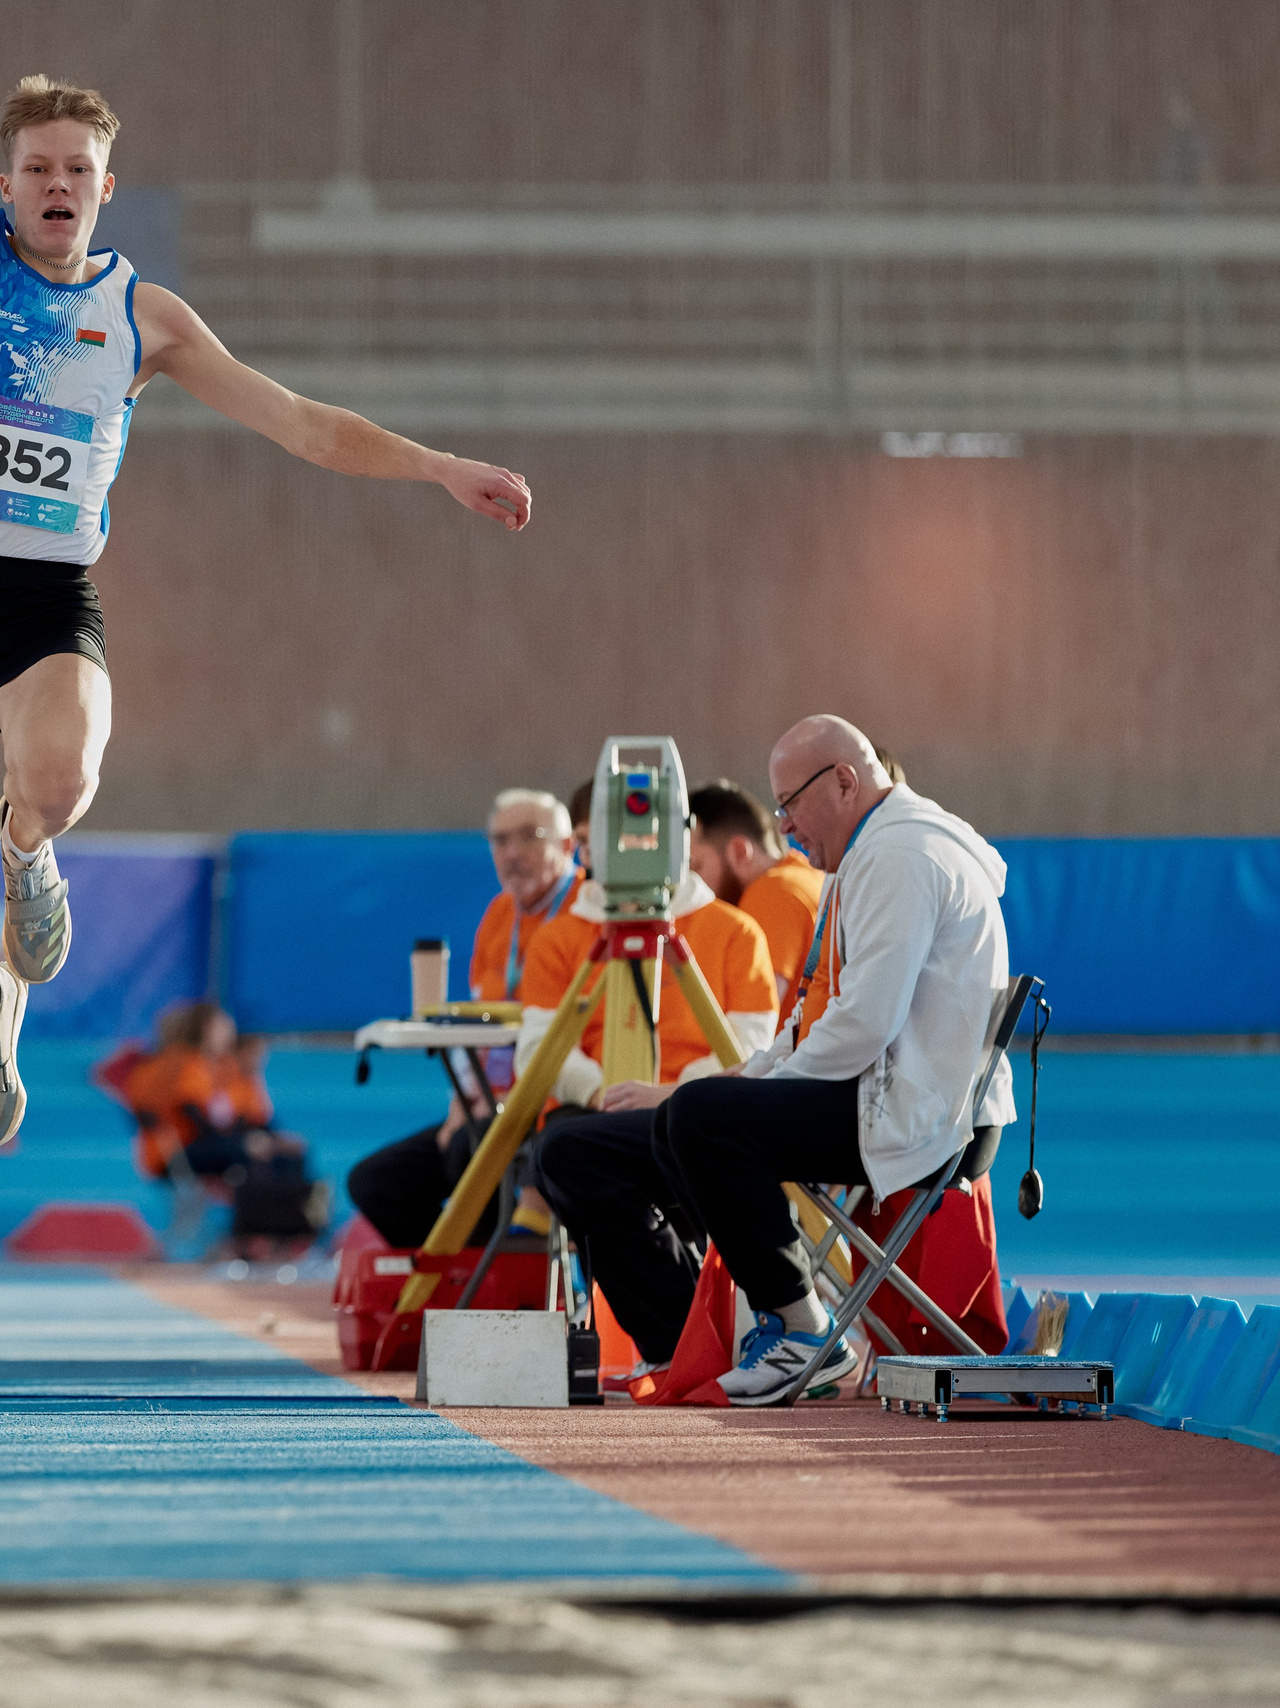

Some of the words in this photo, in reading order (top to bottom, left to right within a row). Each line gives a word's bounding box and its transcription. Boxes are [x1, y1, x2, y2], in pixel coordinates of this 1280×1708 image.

[0, 403, 27, 413] ЗВЁЗДЫ
[28, 409, 55, 420] 2025
[764, 1346, 807, 1375] N
